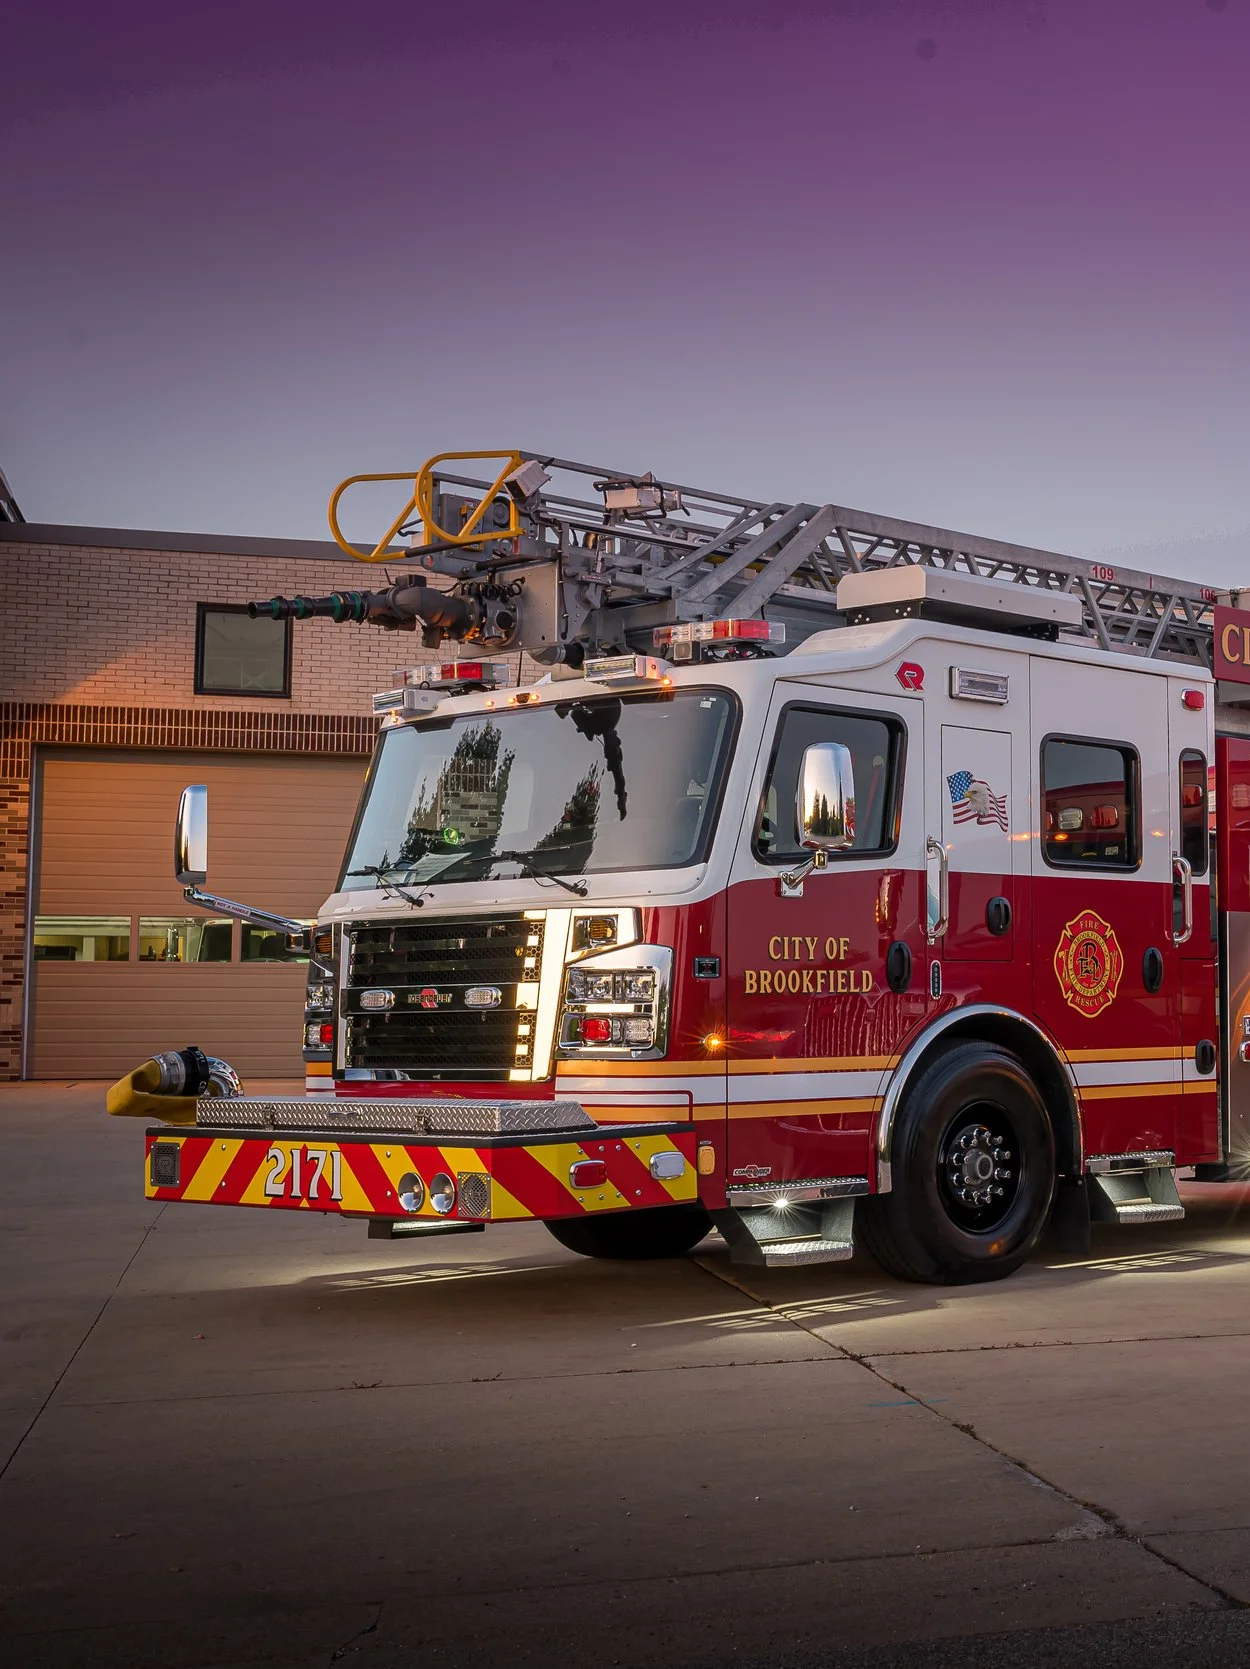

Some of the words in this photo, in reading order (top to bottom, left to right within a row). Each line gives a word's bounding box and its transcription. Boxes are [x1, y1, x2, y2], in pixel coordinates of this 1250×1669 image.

[1092, 565, 1114, 581] 109
[1079, 920, 1100, 931] FIRE
[768, 935, 819, 961] CITY
[825, 936, 850, 960] OF
[744, 969, 874, 994] BROOKFIELD
[1074, 994, 1105, 1008] RESCUE
[264, 1147, 343, 1201] 2171
